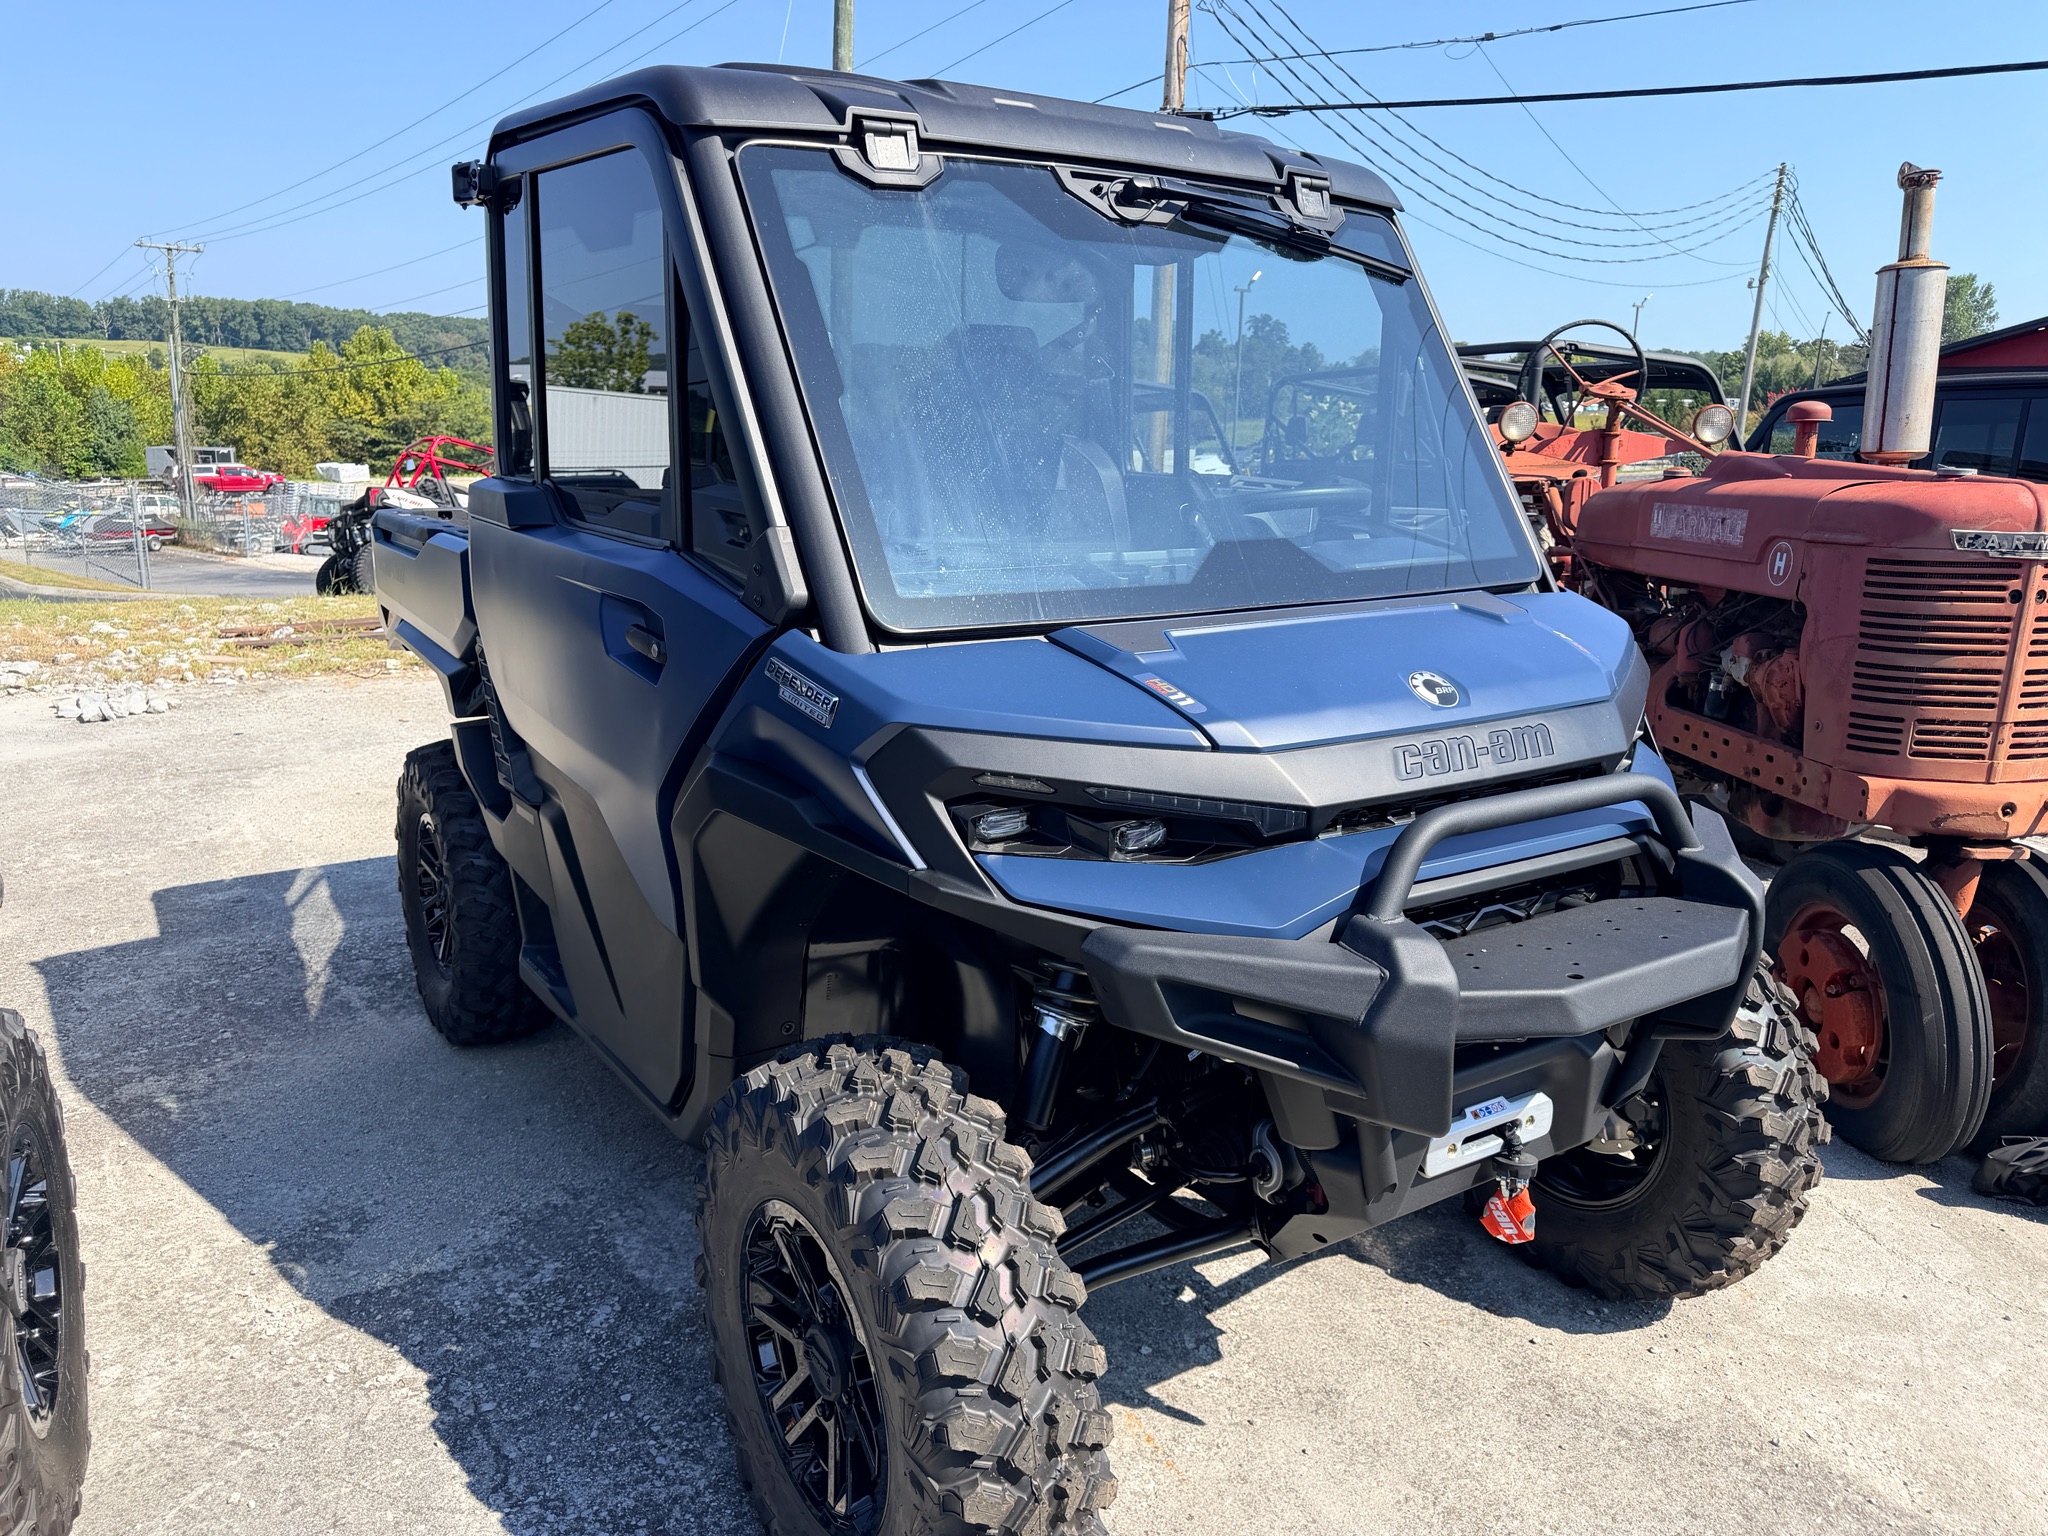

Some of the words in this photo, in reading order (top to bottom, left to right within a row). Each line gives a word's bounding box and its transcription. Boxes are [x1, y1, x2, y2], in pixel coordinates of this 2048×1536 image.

[1964, 533, 2048, 551] FARM
[1773, 551, 1787, 577] H
[767, 661, 832, 711] DEFENDER
[1434, 685, 1455, 695] BRP
[781, 690, 825, 722] LIMITED
[1392, 722, 1555, 782] can-am
